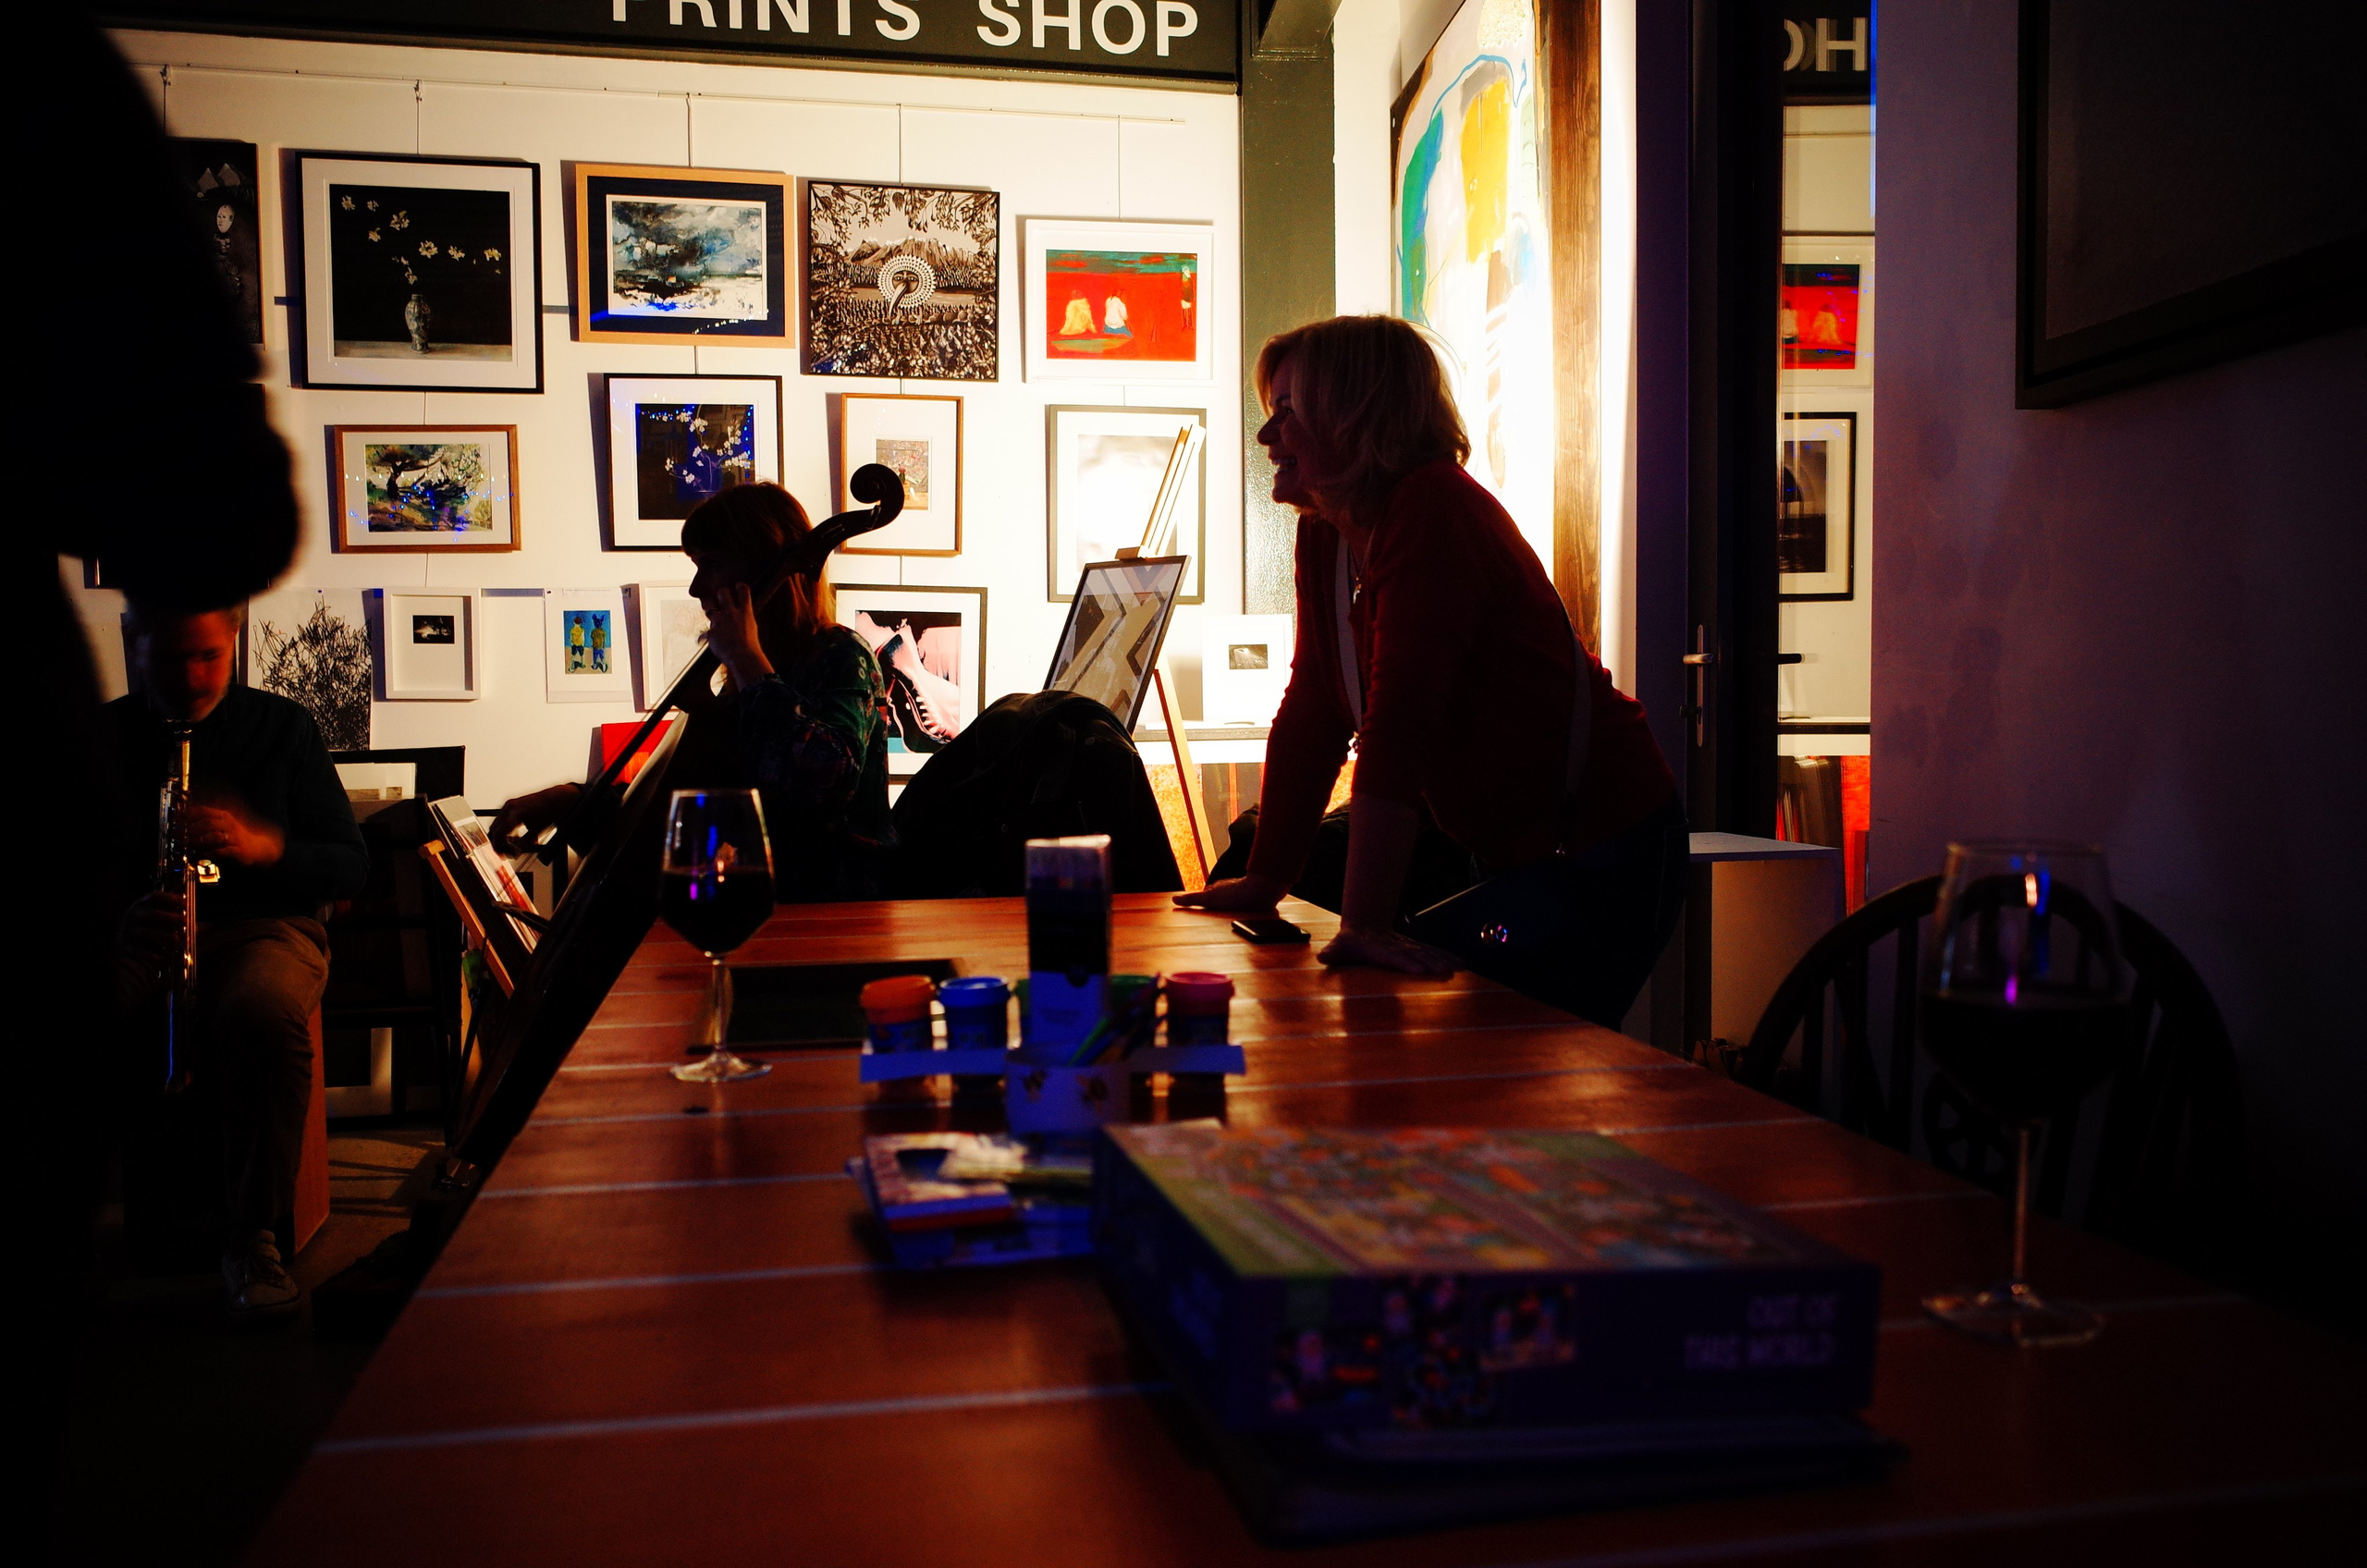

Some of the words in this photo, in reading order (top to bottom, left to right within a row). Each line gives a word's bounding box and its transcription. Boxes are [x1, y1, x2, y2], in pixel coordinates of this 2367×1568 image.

[976, 0, 1199, 56] SHOP
[1747, 1293, 1799, 1329] OUT
[1804, 1292, 1839, 1328] OF
[1747, 1331, 1836, 1367] WORLD
